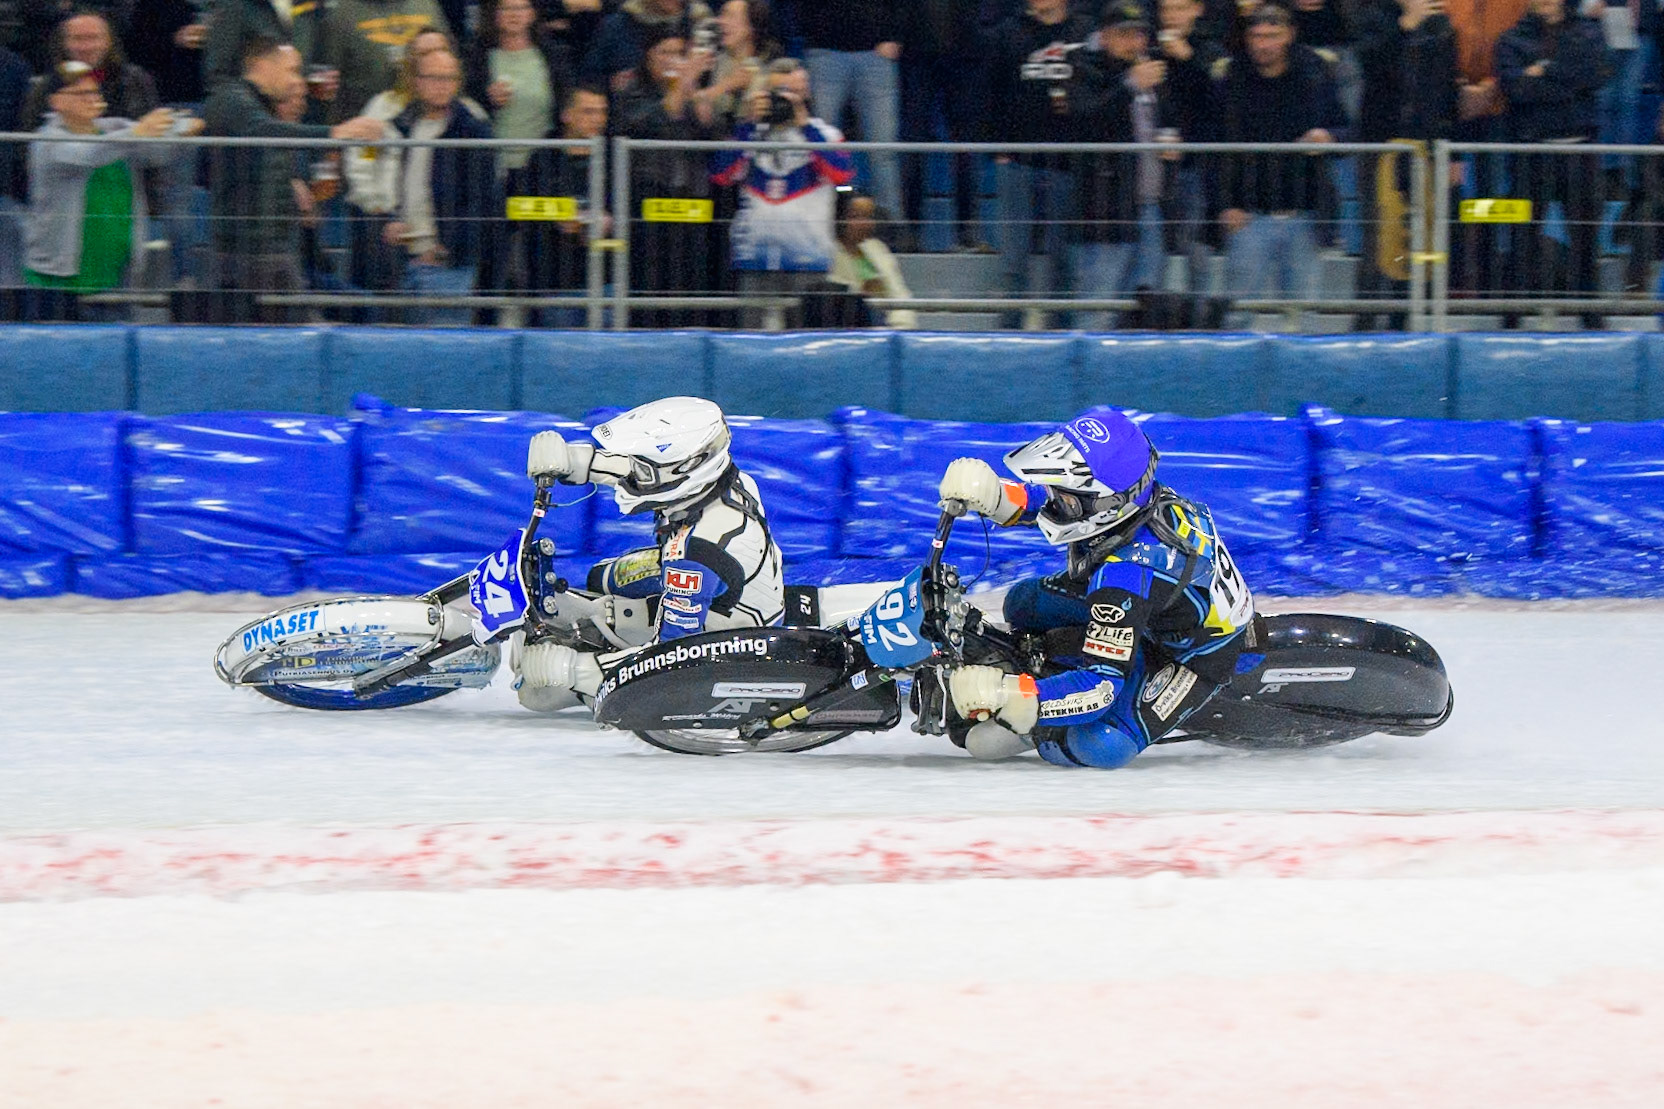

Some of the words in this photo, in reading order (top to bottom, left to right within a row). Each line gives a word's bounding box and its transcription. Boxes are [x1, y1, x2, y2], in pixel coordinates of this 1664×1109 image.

[473, 584, 482, 604] FIM
[482, 549, 515, 619] 24
[800, 594, 811, 615] 24
[243, 610, 319, 652] DYNASET
[863, 614, 878, 644] FIM
[876, 591, 918, 652] 92
[1104, 627, 1132, 641] Life
[618, 636, 768, 686] Brunnsborrning
[1086, 702, 1099, 711] AB
